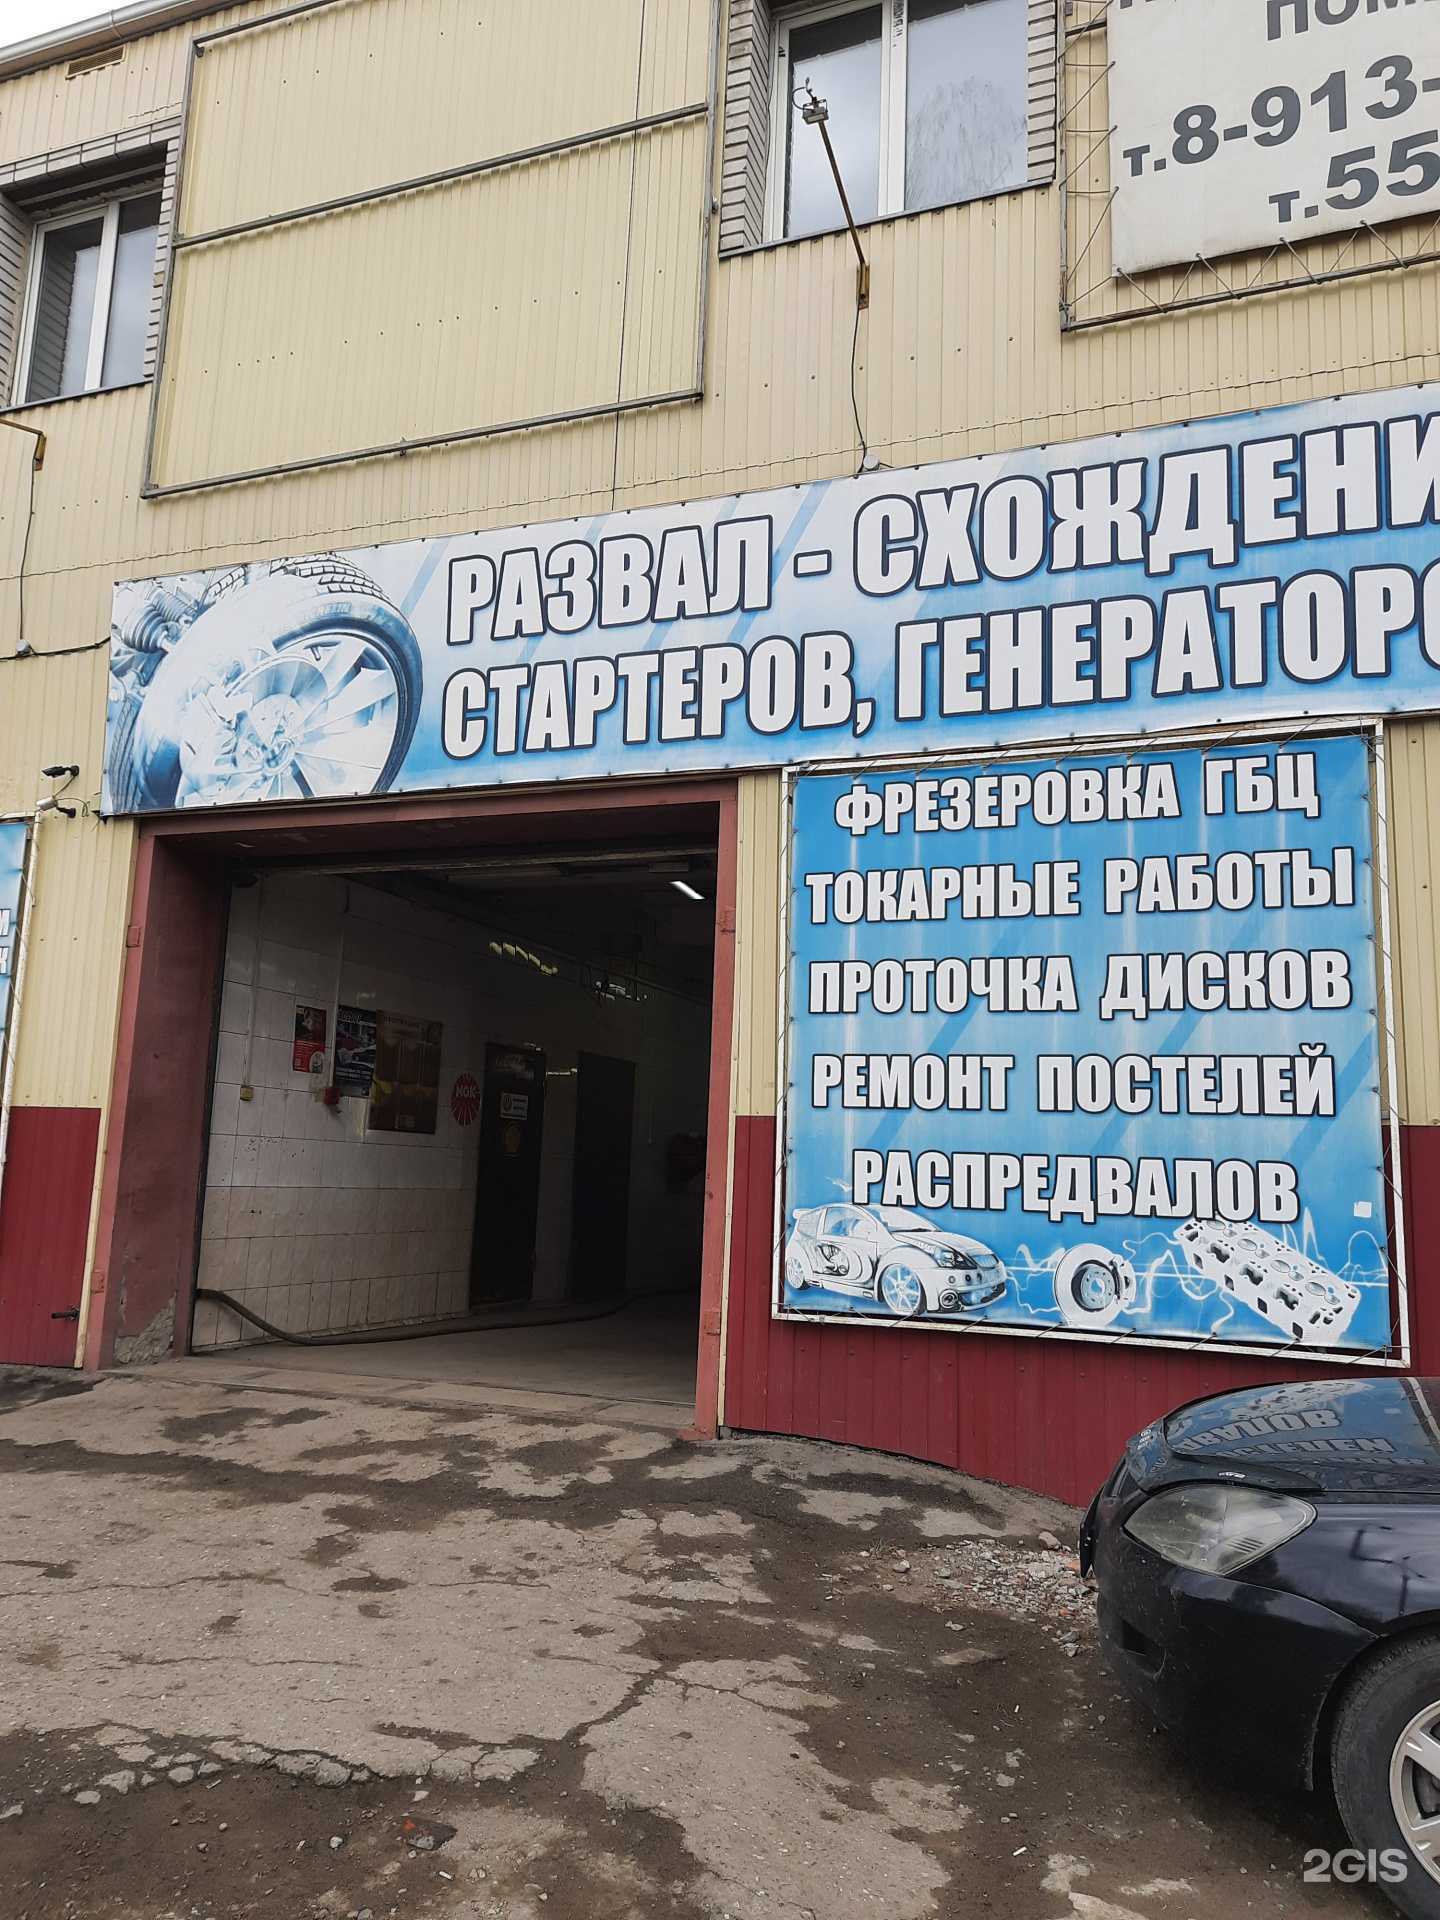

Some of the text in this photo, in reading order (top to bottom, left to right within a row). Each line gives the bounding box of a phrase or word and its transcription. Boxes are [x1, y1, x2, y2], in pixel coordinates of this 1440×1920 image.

[447, 515, 773, 646] РАЗВАЛ
[854, 411, 1440, 597] СХОЖДЕНИ
[441, 631, 876, 761] СТАРТЕРОВ,
[834, 752, 1321, 836] ФРЕЗЕРОВКА ГБЦ
[804, 846, 1355, 925] ТОКАРНЫЕ РАБОТЫ
[808, 948, 1353, 1021] ПРОТОЧКА ДИСКОВ
[812, 1043, 1335, 1116] РЕМОНТ ПОСТЕЛЕЙ
[852, 1149, 1299, 1224] РАСПРЕДВАЛОВ
